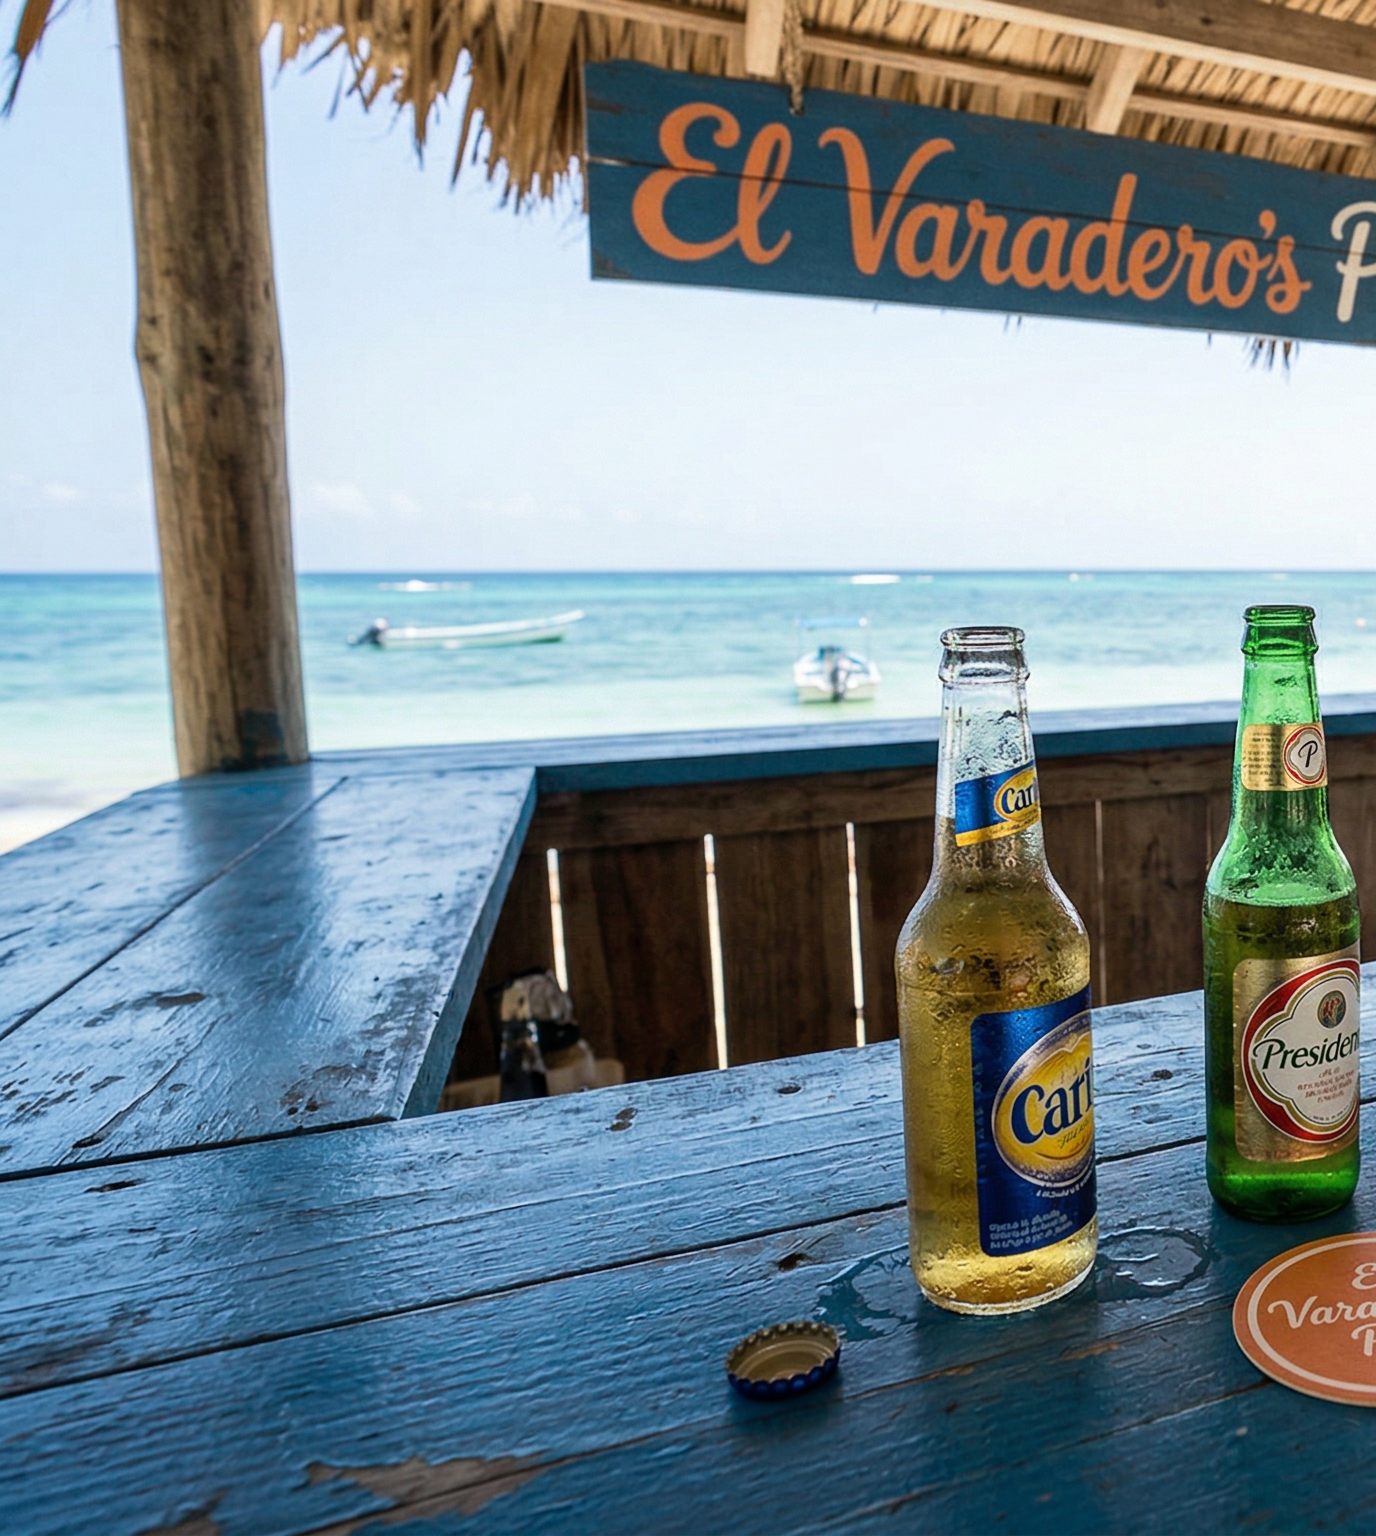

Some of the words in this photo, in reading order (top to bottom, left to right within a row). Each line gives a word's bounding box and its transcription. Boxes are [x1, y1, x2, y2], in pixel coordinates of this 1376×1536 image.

[632, 102, 794, 265] El
[818, 127, 1312, 314] Varadero's
[1298, 740, 1318, 768] P
[1253, 1027, 1360, 1070] Presiden
